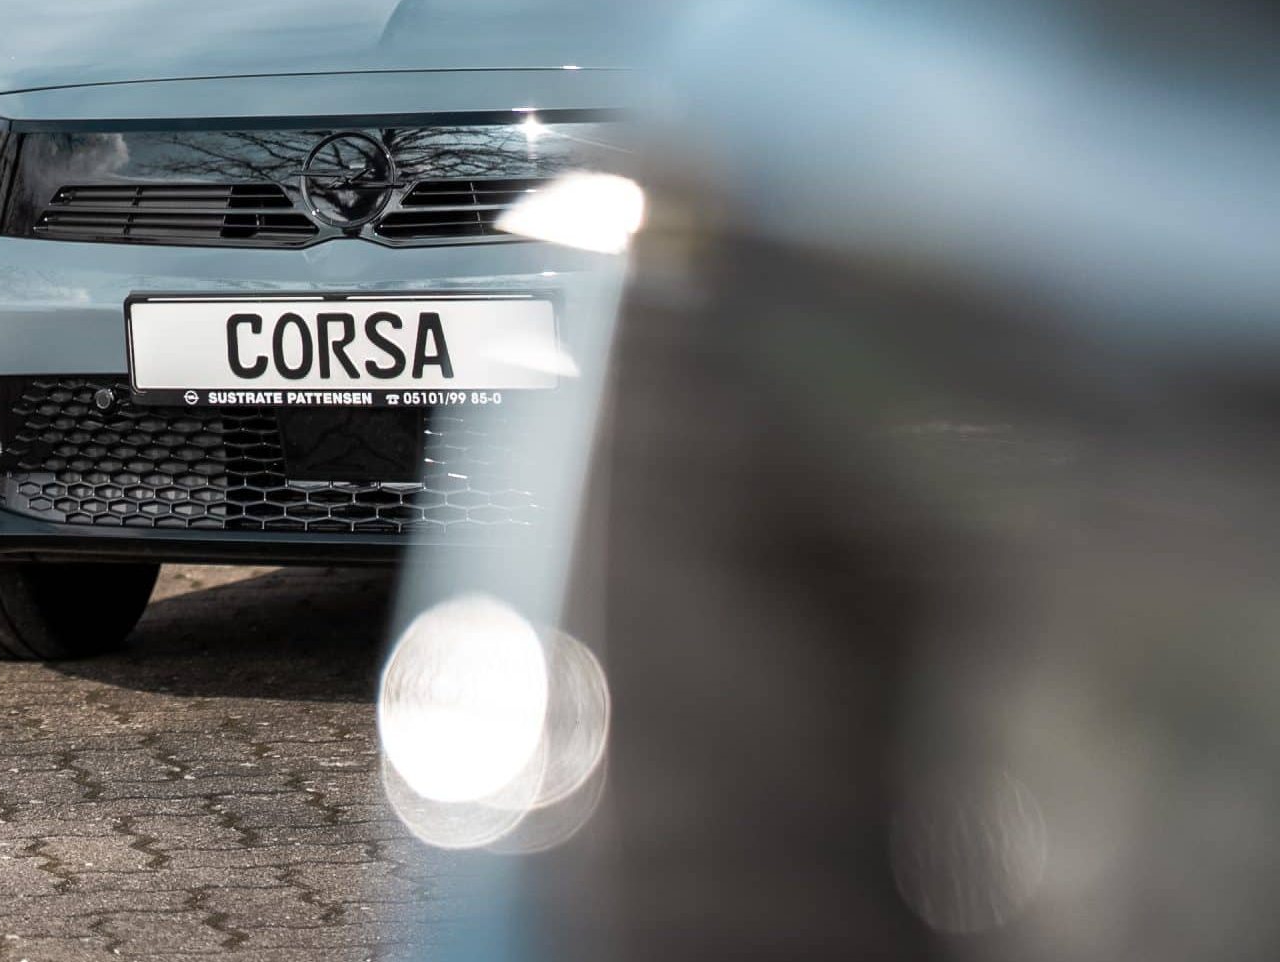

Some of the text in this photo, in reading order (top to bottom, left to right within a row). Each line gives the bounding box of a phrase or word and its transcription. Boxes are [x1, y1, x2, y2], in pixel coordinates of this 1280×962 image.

[226, 311, 454, 380] CORSA
[208, 392, 502, 405] SUSTRATE PATTENSEN 05101/99 85-0
